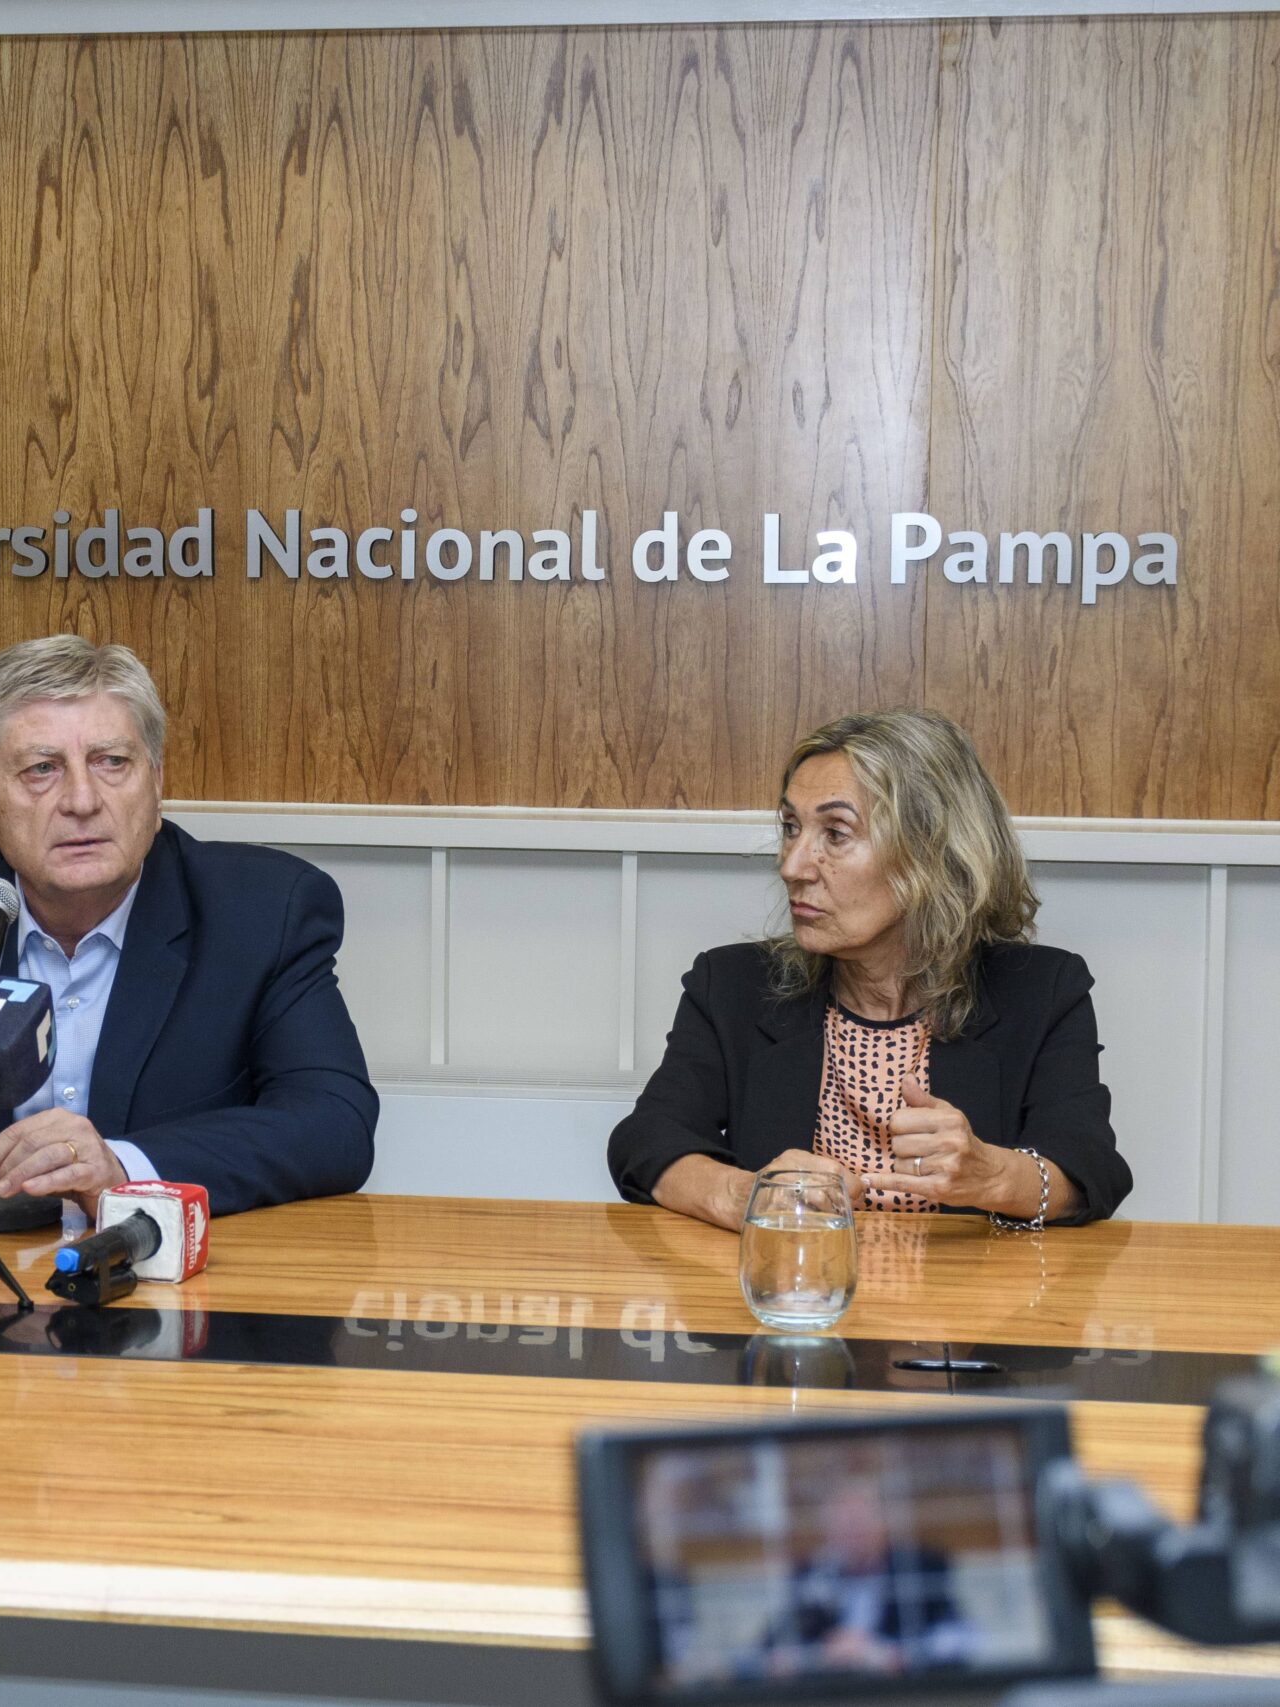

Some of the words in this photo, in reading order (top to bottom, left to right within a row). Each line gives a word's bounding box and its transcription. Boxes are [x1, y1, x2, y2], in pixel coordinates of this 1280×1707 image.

[246, 507, 606, 581] Nacional
[632, 510, 732, 583] de
[763, 513, 858, 584] La
[890, 511, 1178, 605] Pampa
